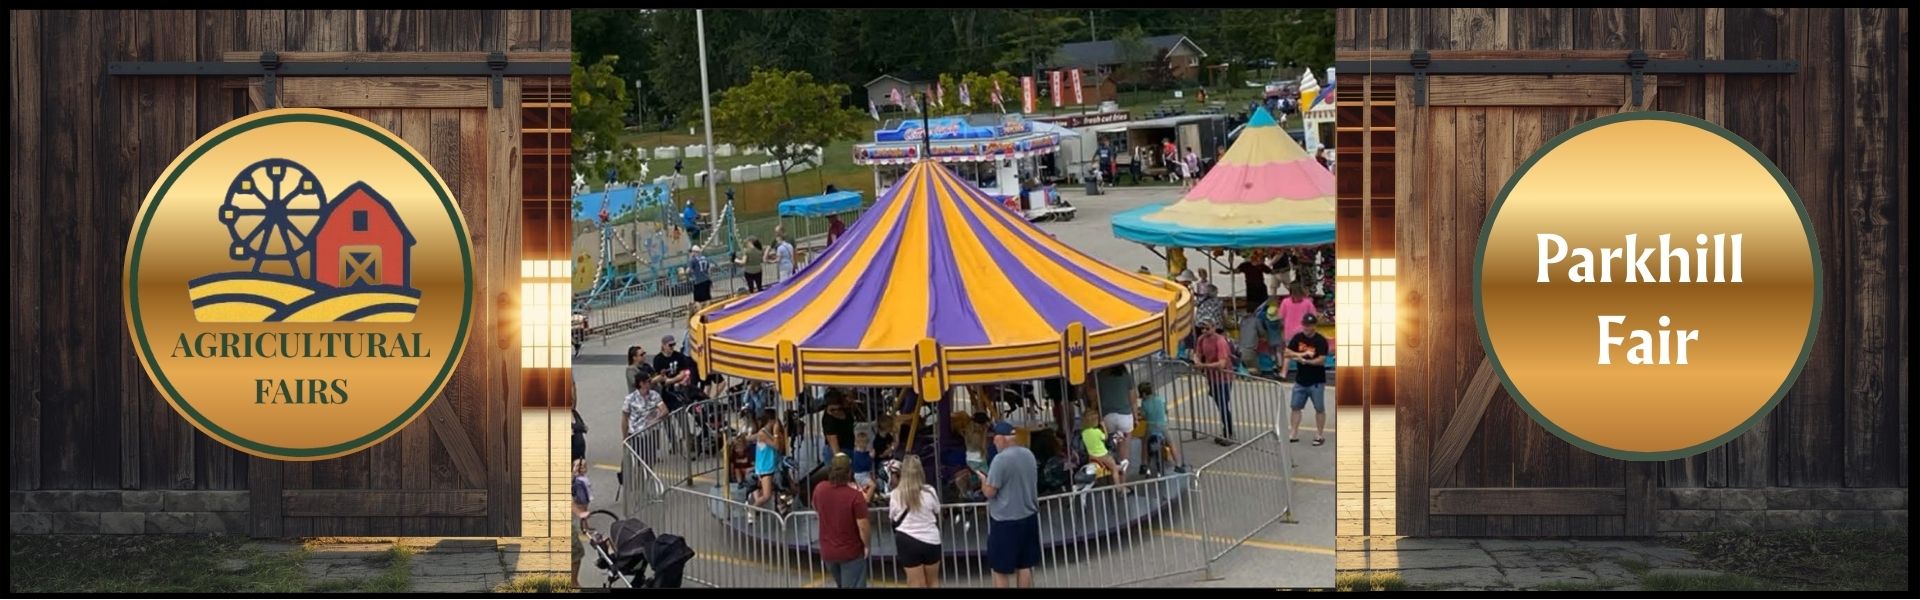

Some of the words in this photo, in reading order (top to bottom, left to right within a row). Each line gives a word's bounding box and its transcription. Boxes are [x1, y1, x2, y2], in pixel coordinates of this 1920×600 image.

[1083, 115, 1101, 125] fresh
[1101, 114, 1112, 123] cut
[1112, 113, 1128, 121] fries
